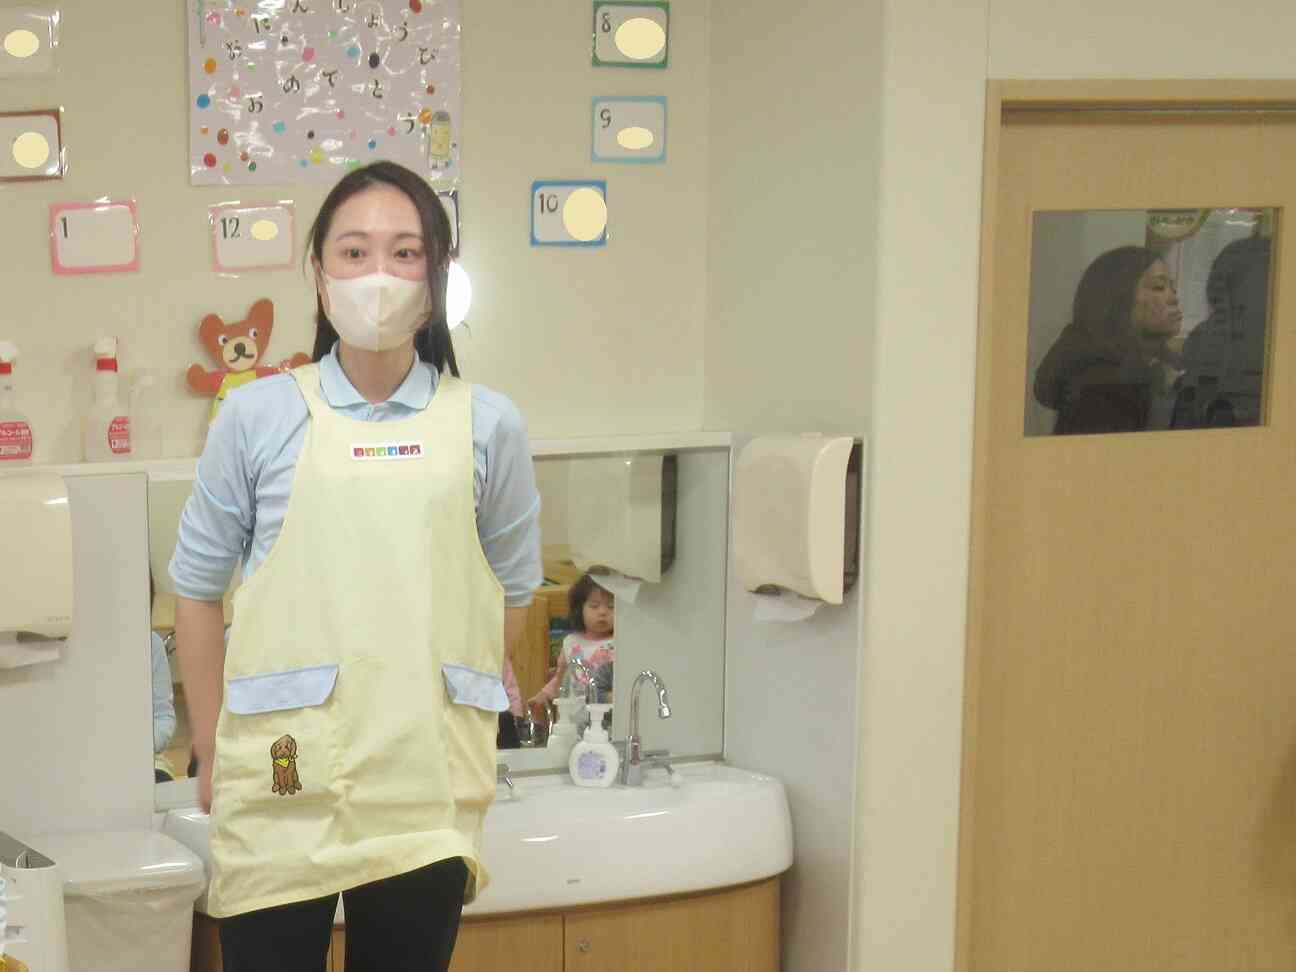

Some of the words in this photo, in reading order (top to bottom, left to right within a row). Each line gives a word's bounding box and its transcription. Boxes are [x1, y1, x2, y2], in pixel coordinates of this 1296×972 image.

[601, 12, 612, 33] 8
[600, 108, 612, 129] 9
[538, 193, 559, 213] 10
[60, 217, 69, 238] 1
[220, 217, 241, 239] 12
